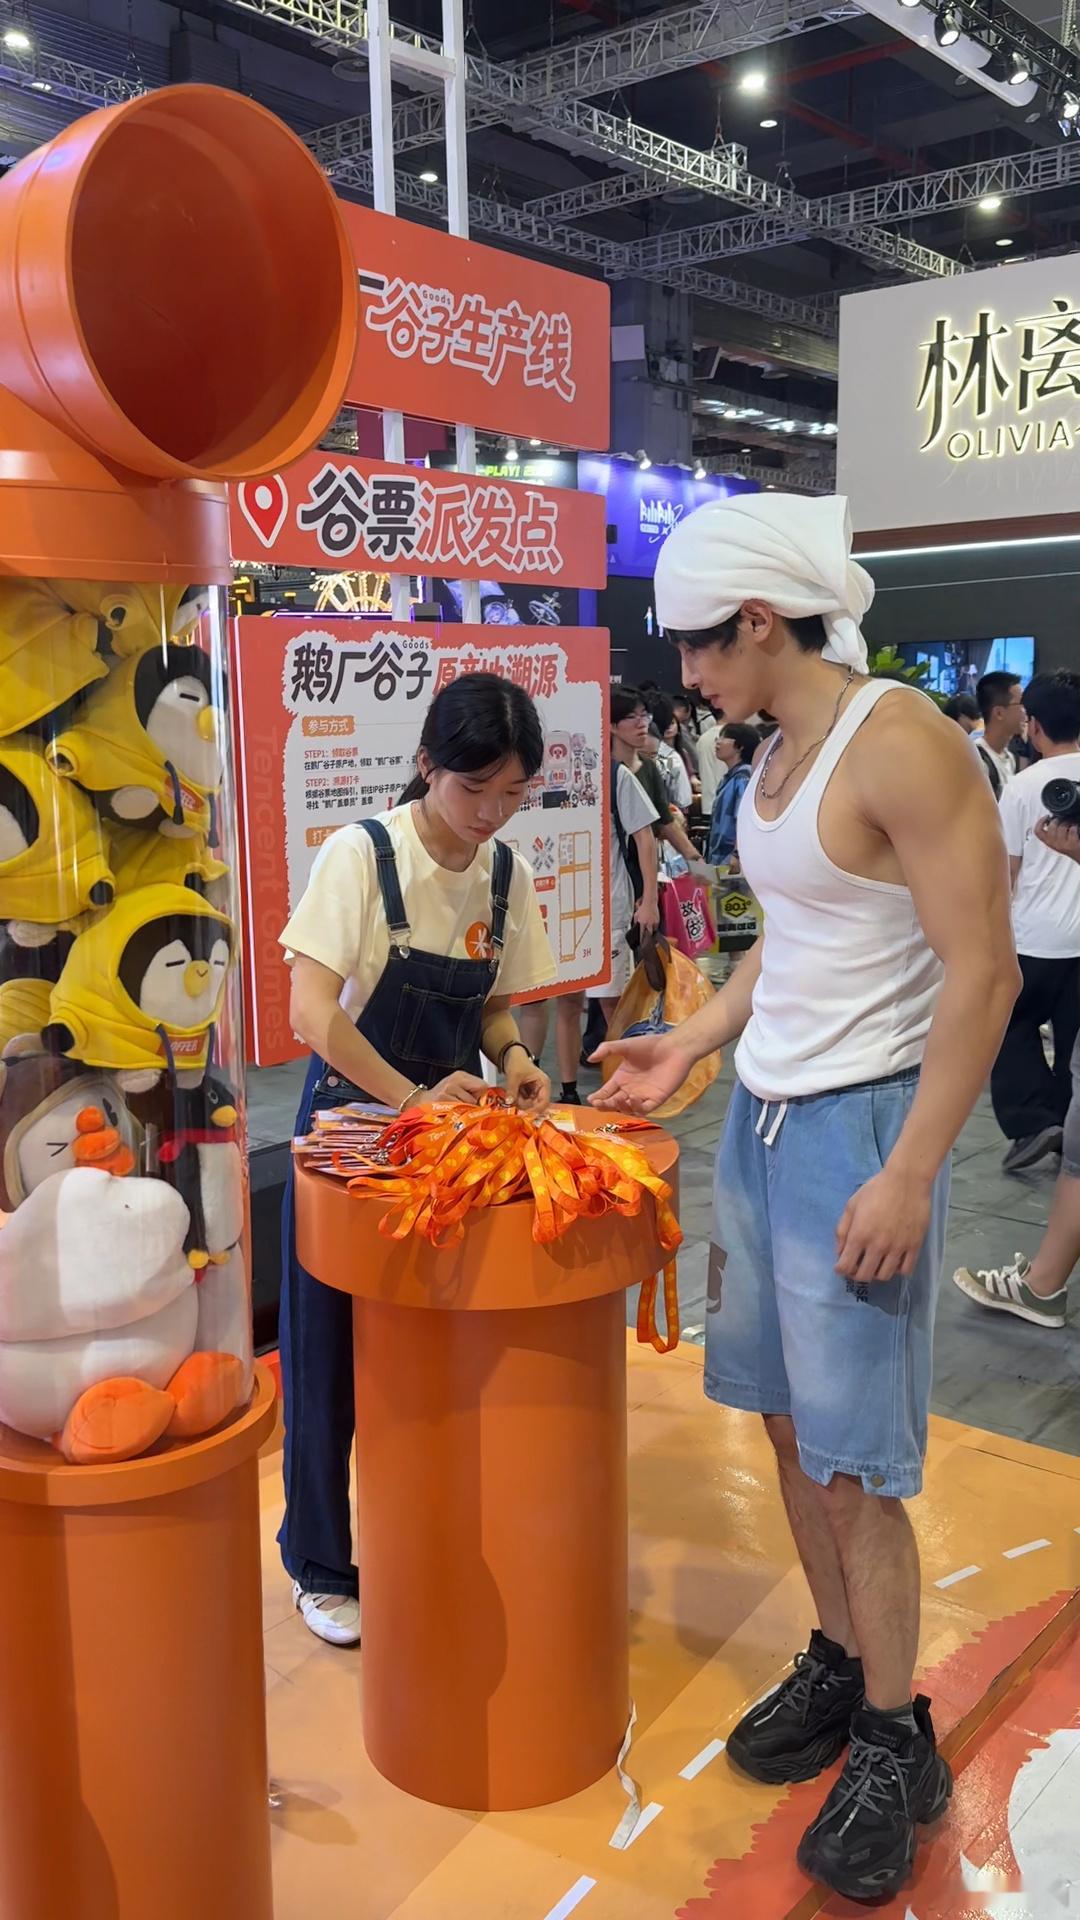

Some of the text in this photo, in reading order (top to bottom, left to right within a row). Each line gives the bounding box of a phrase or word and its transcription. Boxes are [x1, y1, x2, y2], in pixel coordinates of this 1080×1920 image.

[422, 290, 451, 305] Goods
[917, 299, 1080, 451] 林离
[947, 420, 1070, 459] OLIVIA
[297, 462, 563, 575] 谷票派发点
[402, 640, 429, 649] Goods
[308, 718, 349, 733] 参与方式
